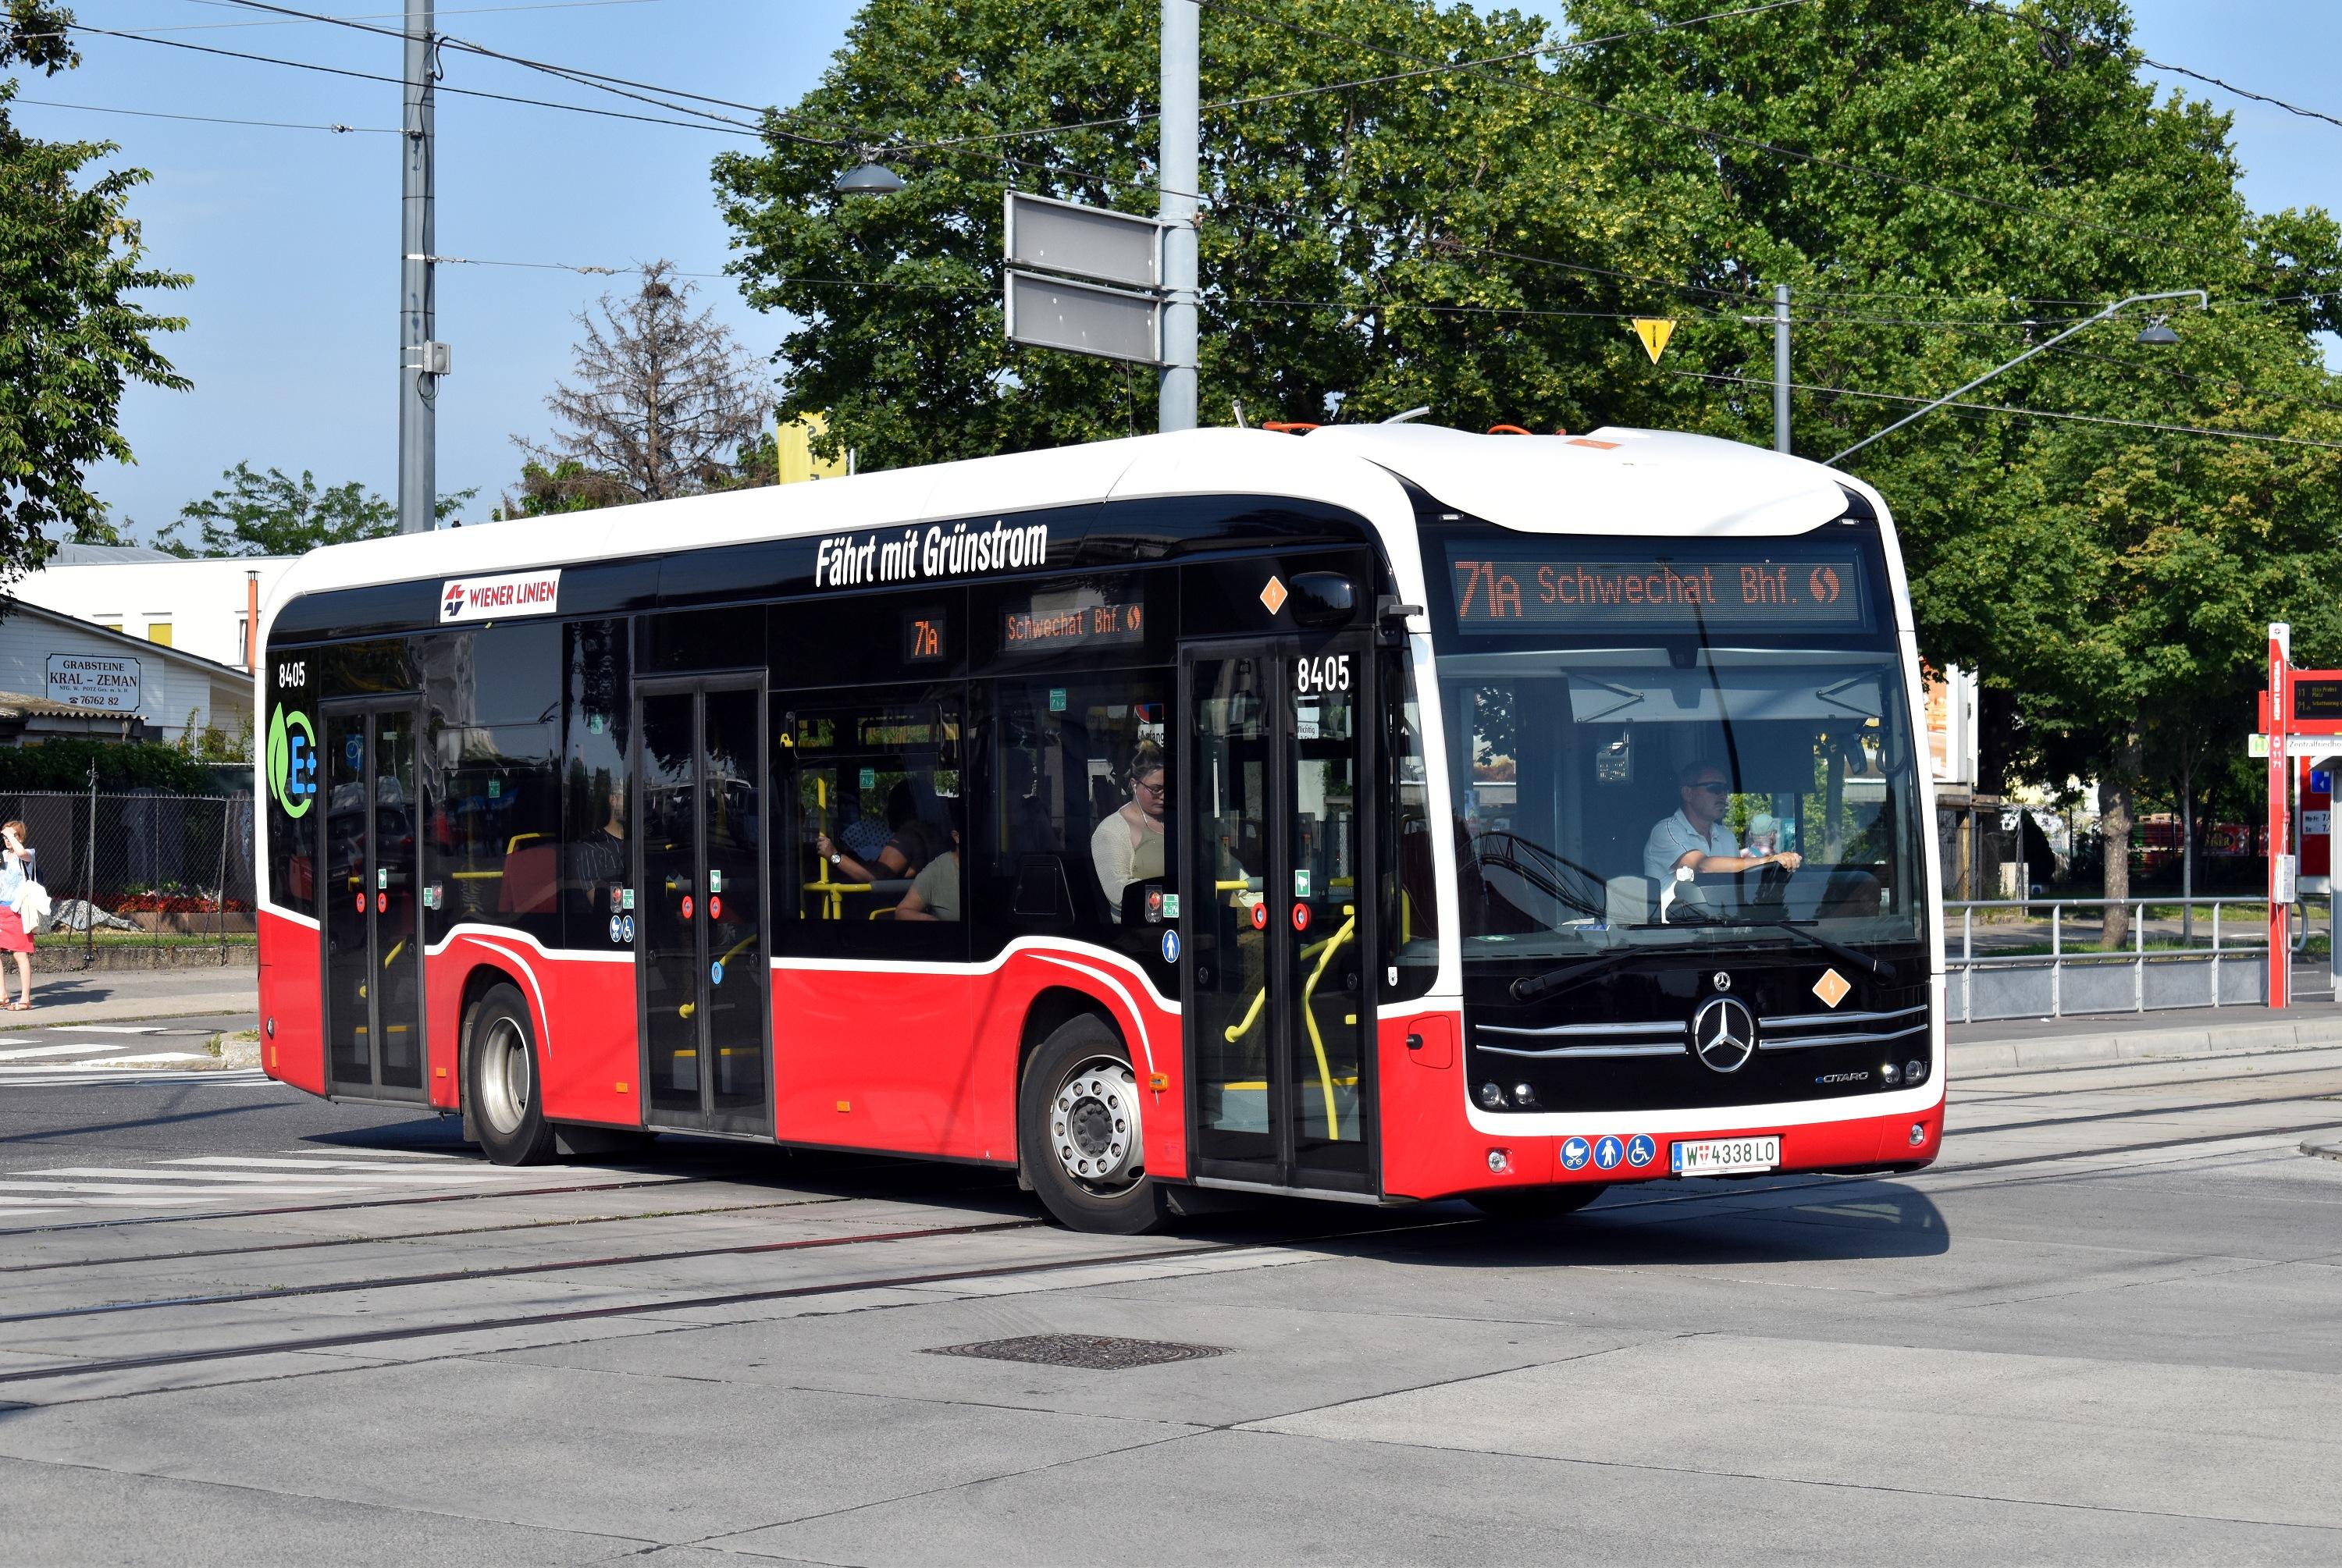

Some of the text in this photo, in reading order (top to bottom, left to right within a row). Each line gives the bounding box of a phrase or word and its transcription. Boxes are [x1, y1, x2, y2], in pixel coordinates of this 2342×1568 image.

[816, 520, 1048, 588] Fährt mit Grünstrom
[470, 581, 556, 608] WIENER LINIEN
[1455, 561, 1797, 617] 71A Schwechat Bhf.
[1009, 607, 1119, 640] Schwechat Bhf.
[914, 620, 938, 656] 71A
[63, 660, 125, 671] GRABSTEINE
[279, 662, 305, 688] 8405
[1297, 656, 1349, 692] 8405
[50, 672, 84, 684] KRAL
[97, 674, 137, 687] ZEMAN
[80, 695, 104, 705] 76762
[2255, 739, 2265, 751] H
